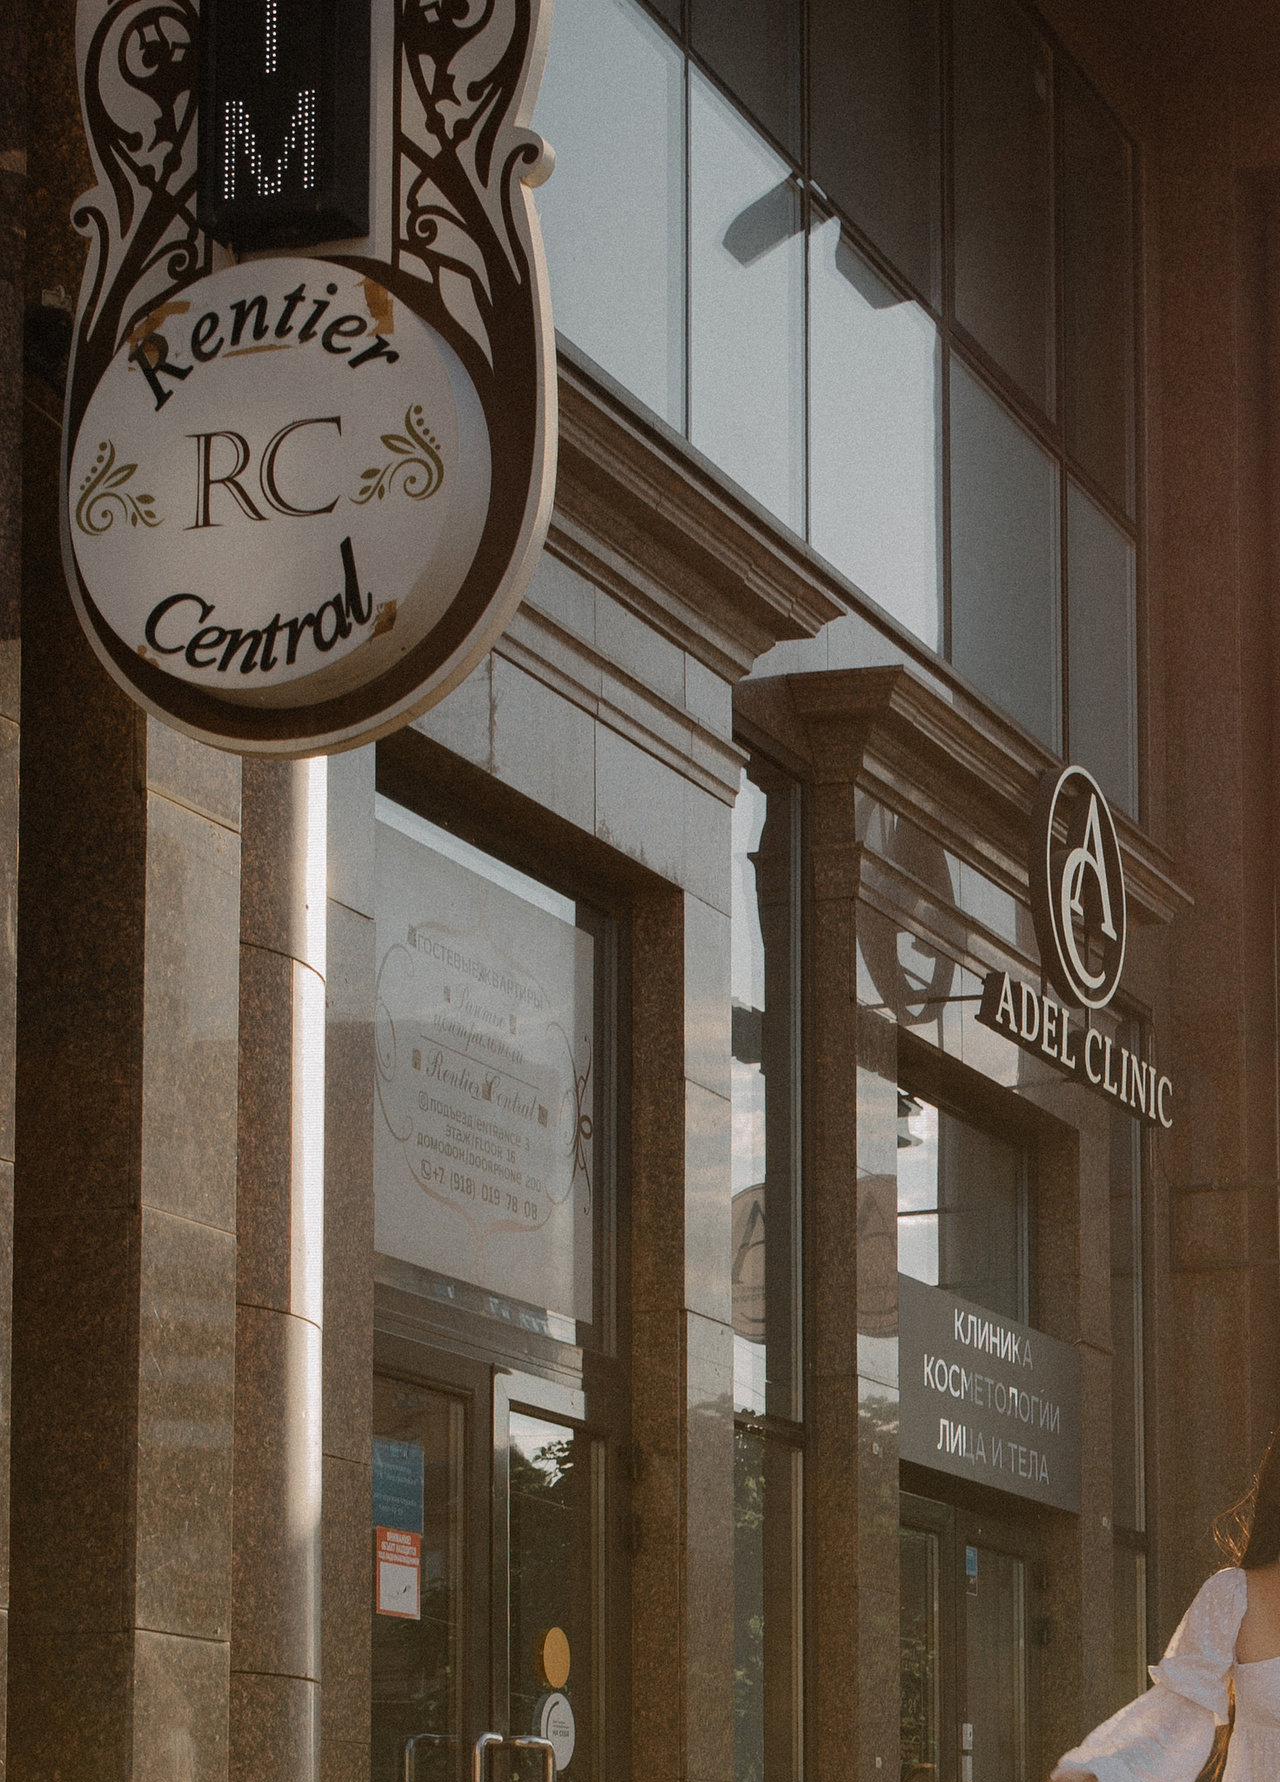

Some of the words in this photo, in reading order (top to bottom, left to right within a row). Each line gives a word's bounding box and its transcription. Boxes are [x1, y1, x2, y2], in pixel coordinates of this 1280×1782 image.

[129, 283, 400, 412] Rentier
[183, 416, 343, 530] RC
[144, 536, 374, 674] Central
[995, 971, 1076, 1069] ADEL
[1085, 1028, 1173, 1128] CLINIC
[924, 1353, 1060, 1435] КОСМЕТОЛОГИИ
[954, 1308, 1033, 1370] КЛИНИКА
[937, 1418, 987, 1465] ЛИЦА
[992, 1436, 1002, 1469] И
[1008, 1442, 1050, 1485] ТЕЛА
